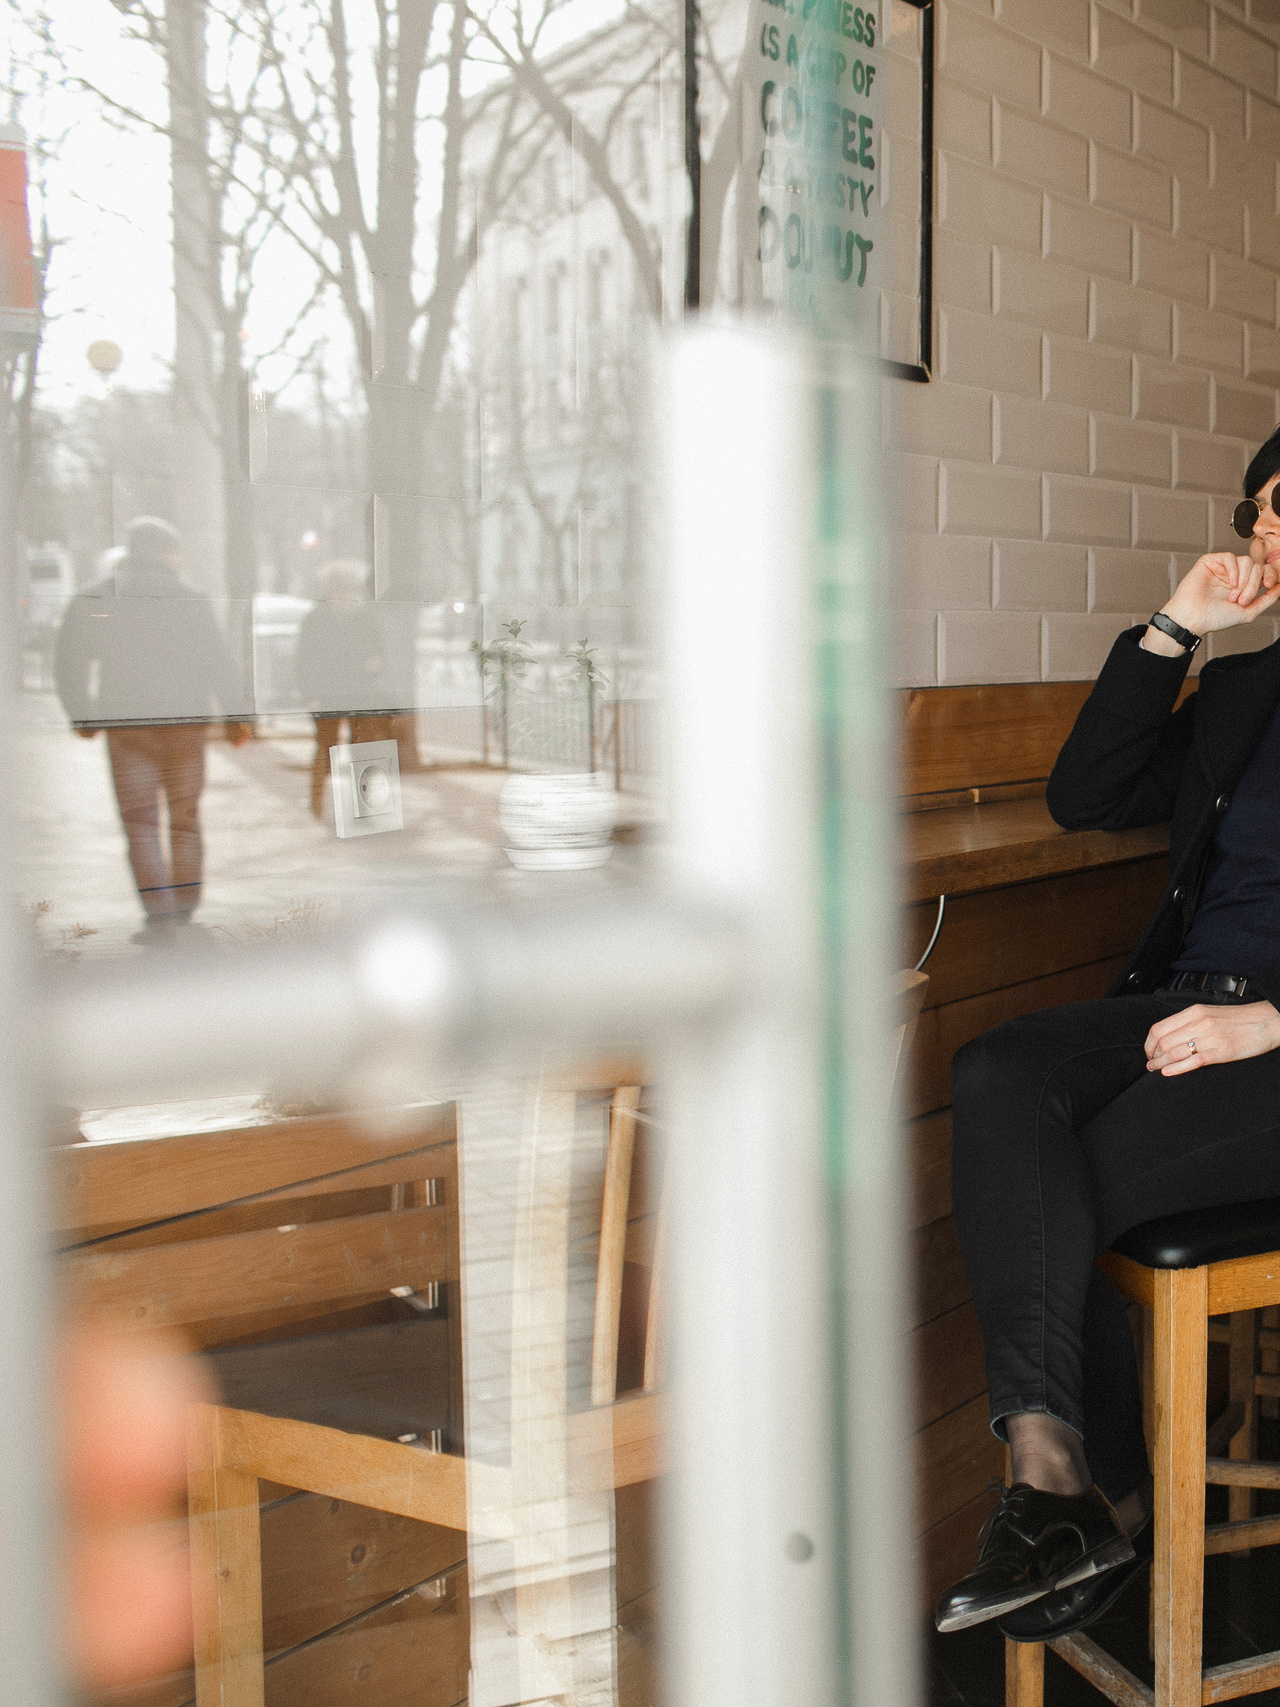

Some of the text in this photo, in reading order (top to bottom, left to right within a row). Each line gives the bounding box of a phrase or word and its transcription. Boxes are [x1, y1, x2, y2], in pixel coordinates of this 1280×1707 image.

[761, 22, 780, 61] IS
[786, 33, 799, 70] A
[852, 59, 876, 98] OF
